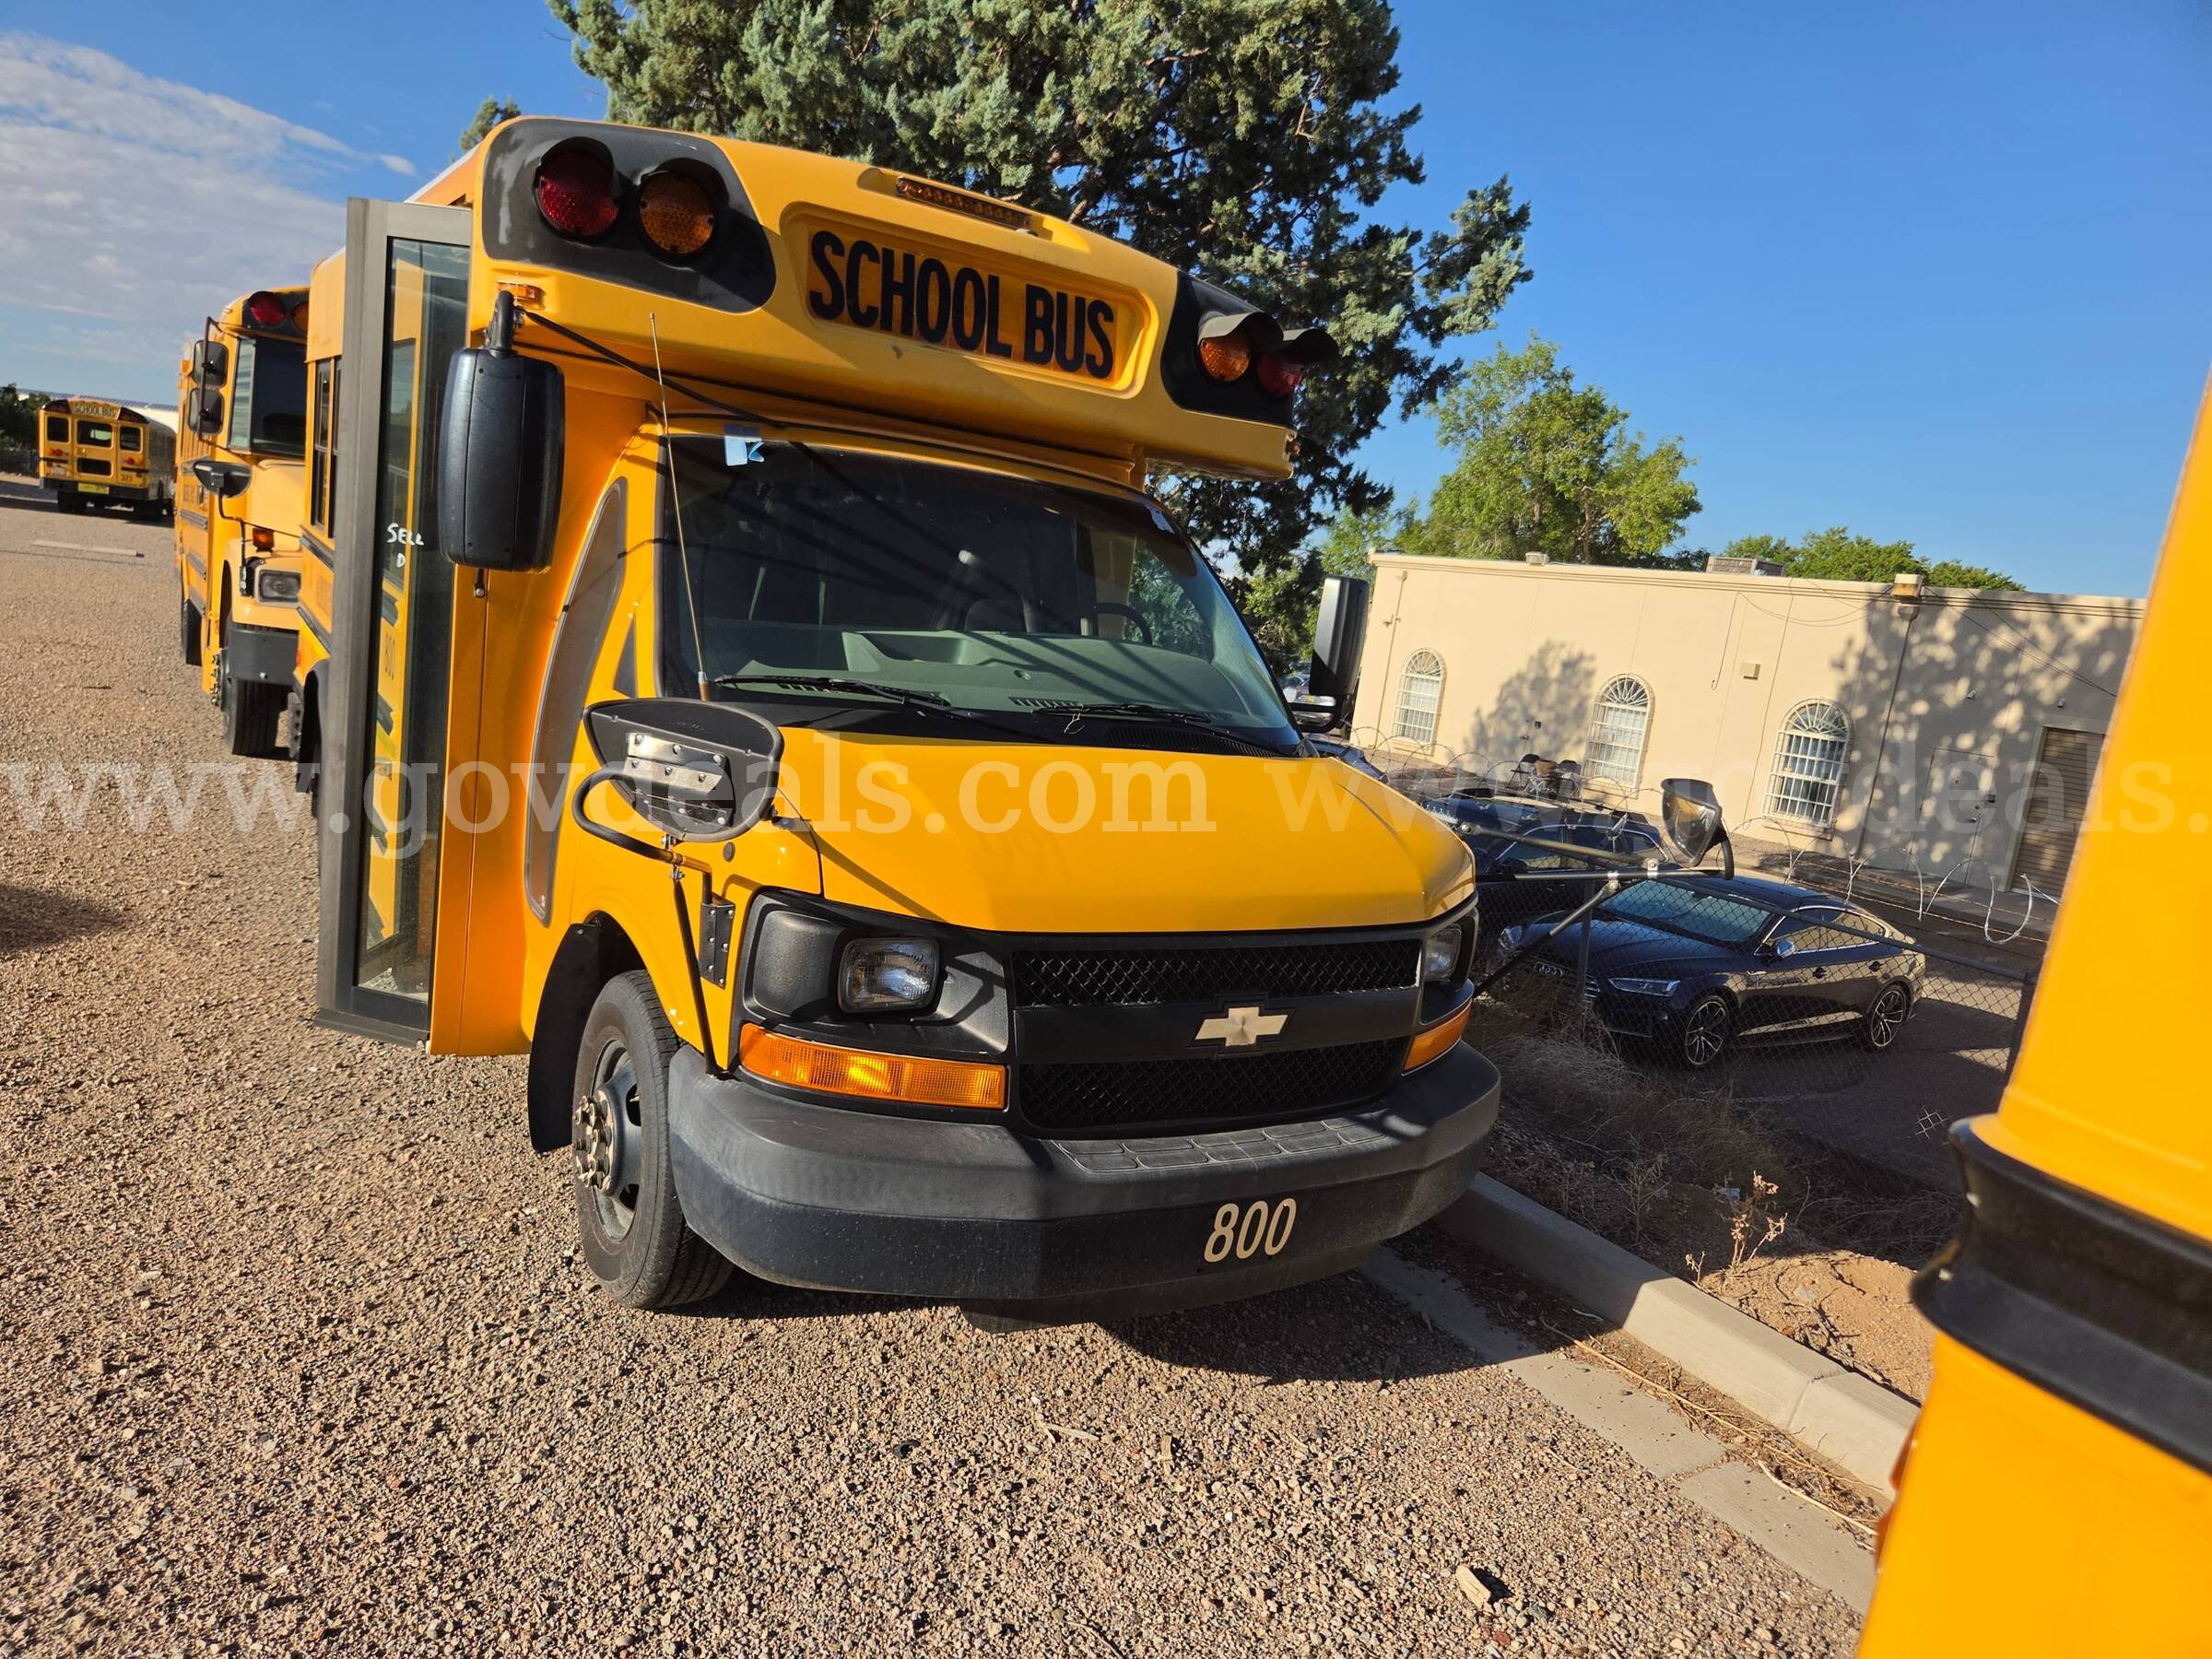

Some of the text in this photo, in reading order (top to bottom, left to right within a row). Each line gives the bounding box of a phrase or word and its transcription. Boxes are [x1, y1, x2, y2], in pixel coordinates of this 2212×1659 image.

[809, 229, 1114, 379] SCHOOL BUS
[74, 404, 115, 418] SCHOOL BUS
[1204, 1197, 1297, 1263] 800
